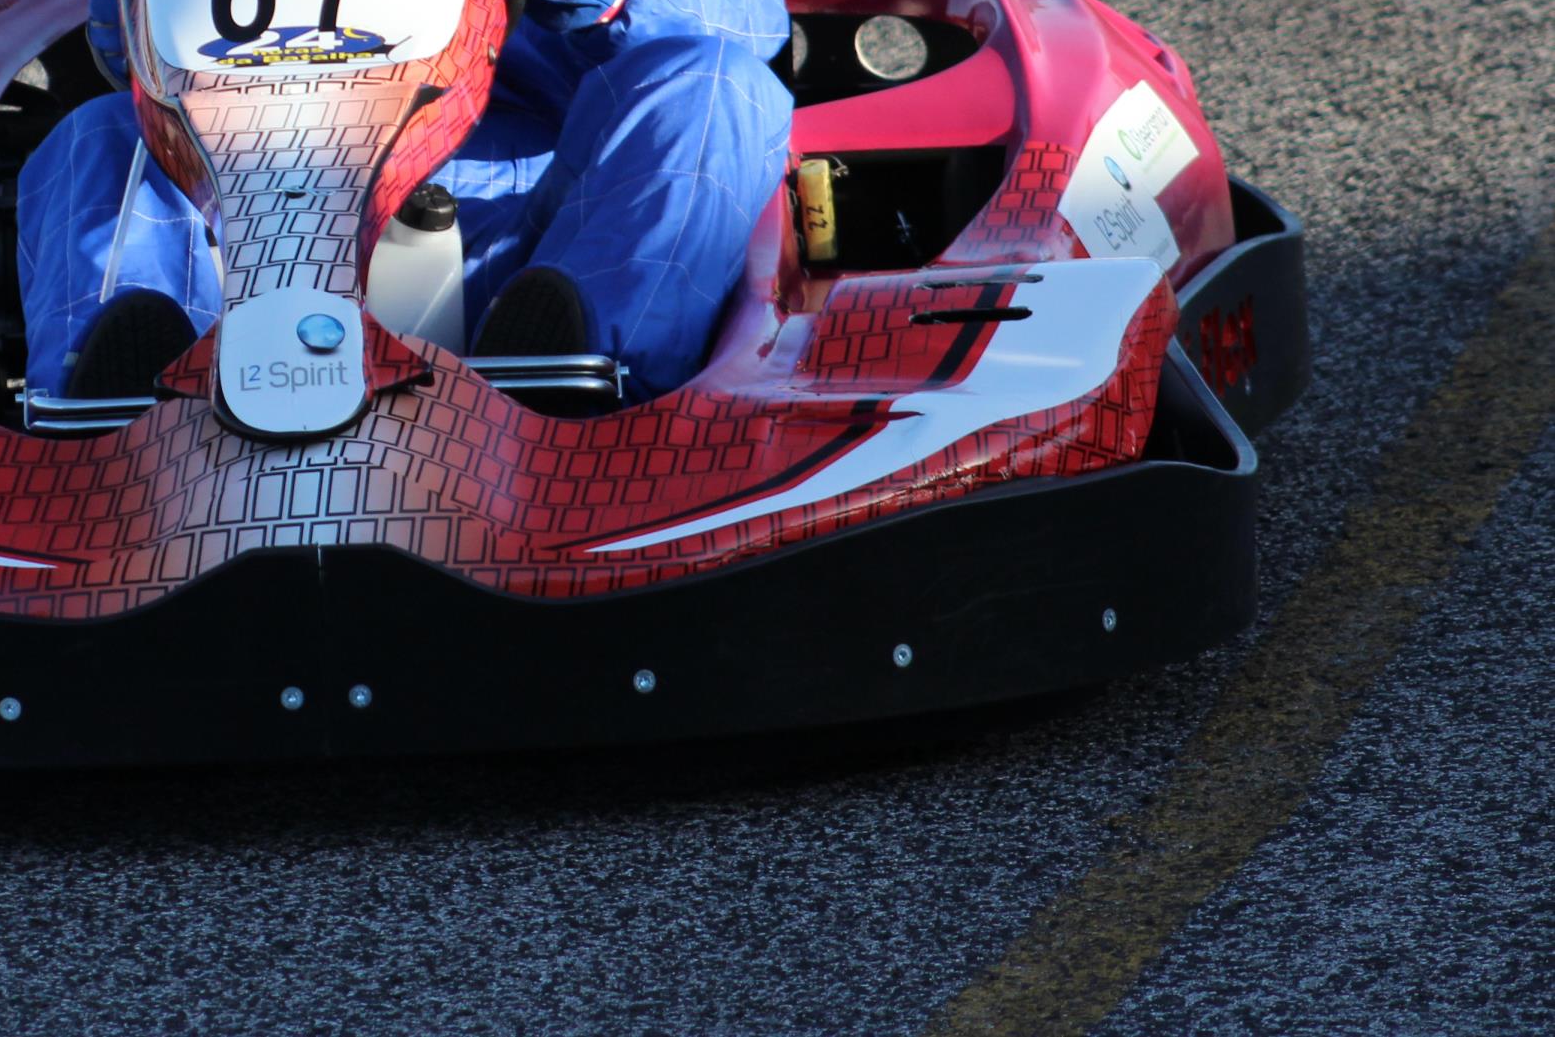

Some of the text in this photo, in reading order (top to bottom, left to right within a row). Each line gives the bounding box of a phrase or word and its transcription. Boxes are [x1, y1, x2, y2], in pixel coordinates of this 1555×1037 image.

[225, 28, 344, 55] 24
[263, 51, 375, 63] Batalha
[268, 360, 350, 394] Spirit
